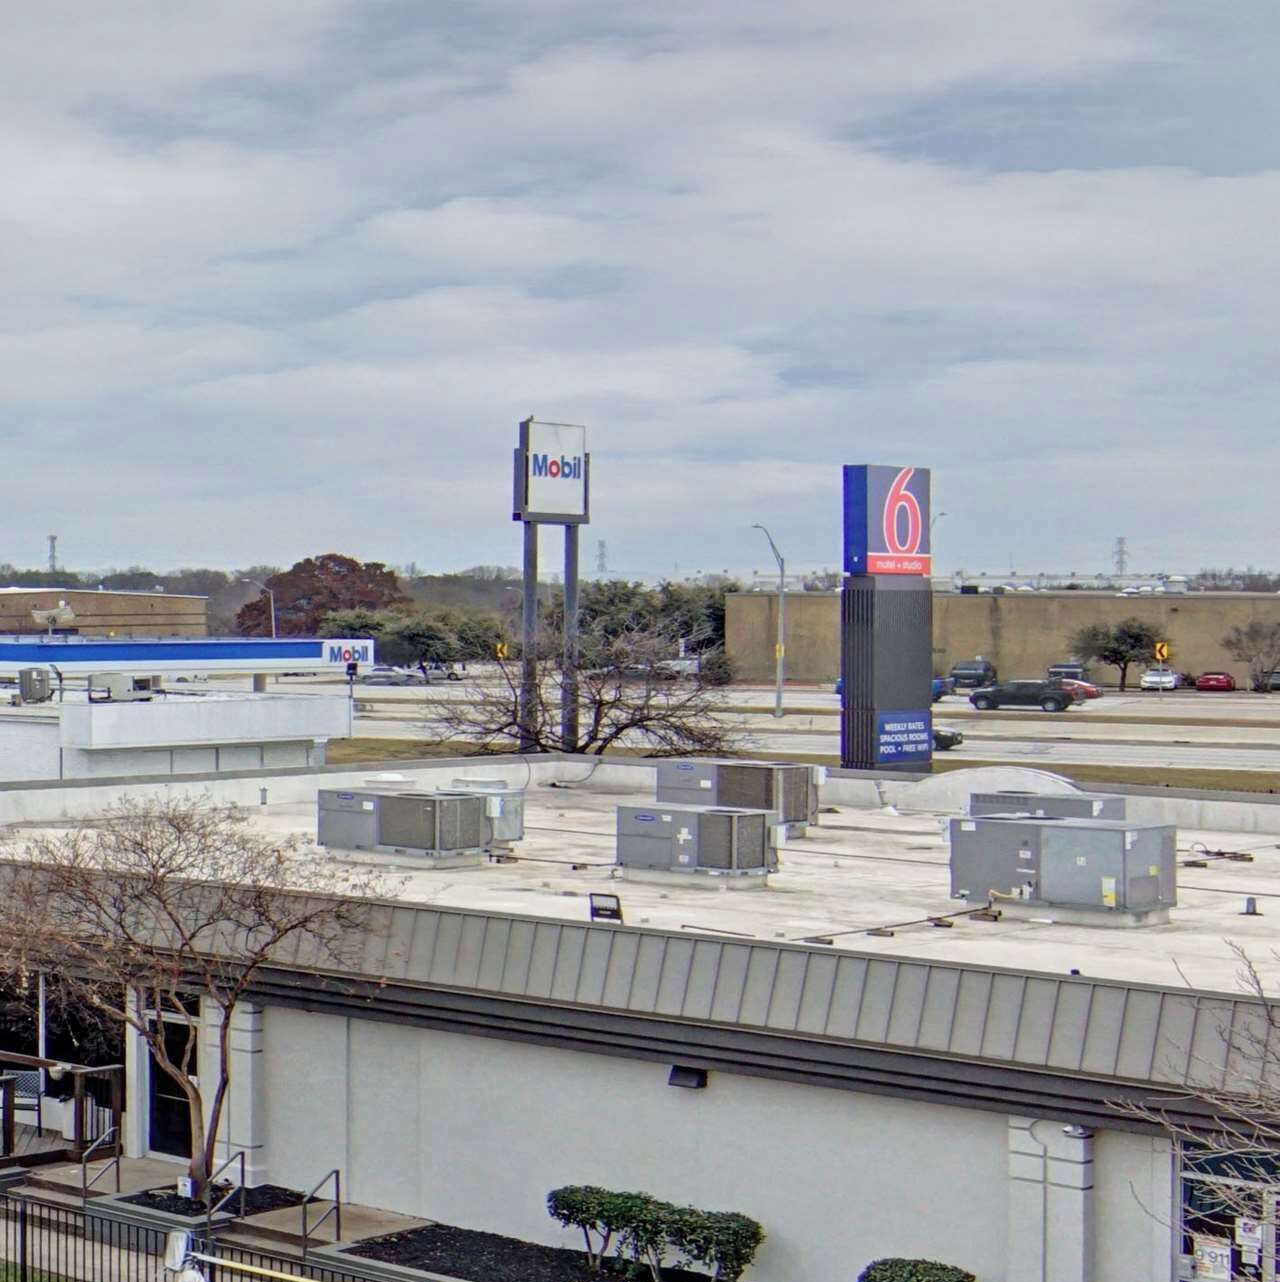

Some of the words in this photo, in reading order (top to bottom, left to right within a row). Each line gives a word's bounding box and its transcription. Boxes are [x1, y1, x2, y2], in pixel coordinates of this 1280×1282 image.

[532, 453, 581, 479] Mobil
[883, 467, 922, 554] 6
[330, 646, 368, 662] Mobil
[880, 745, 896, 754] POOL
